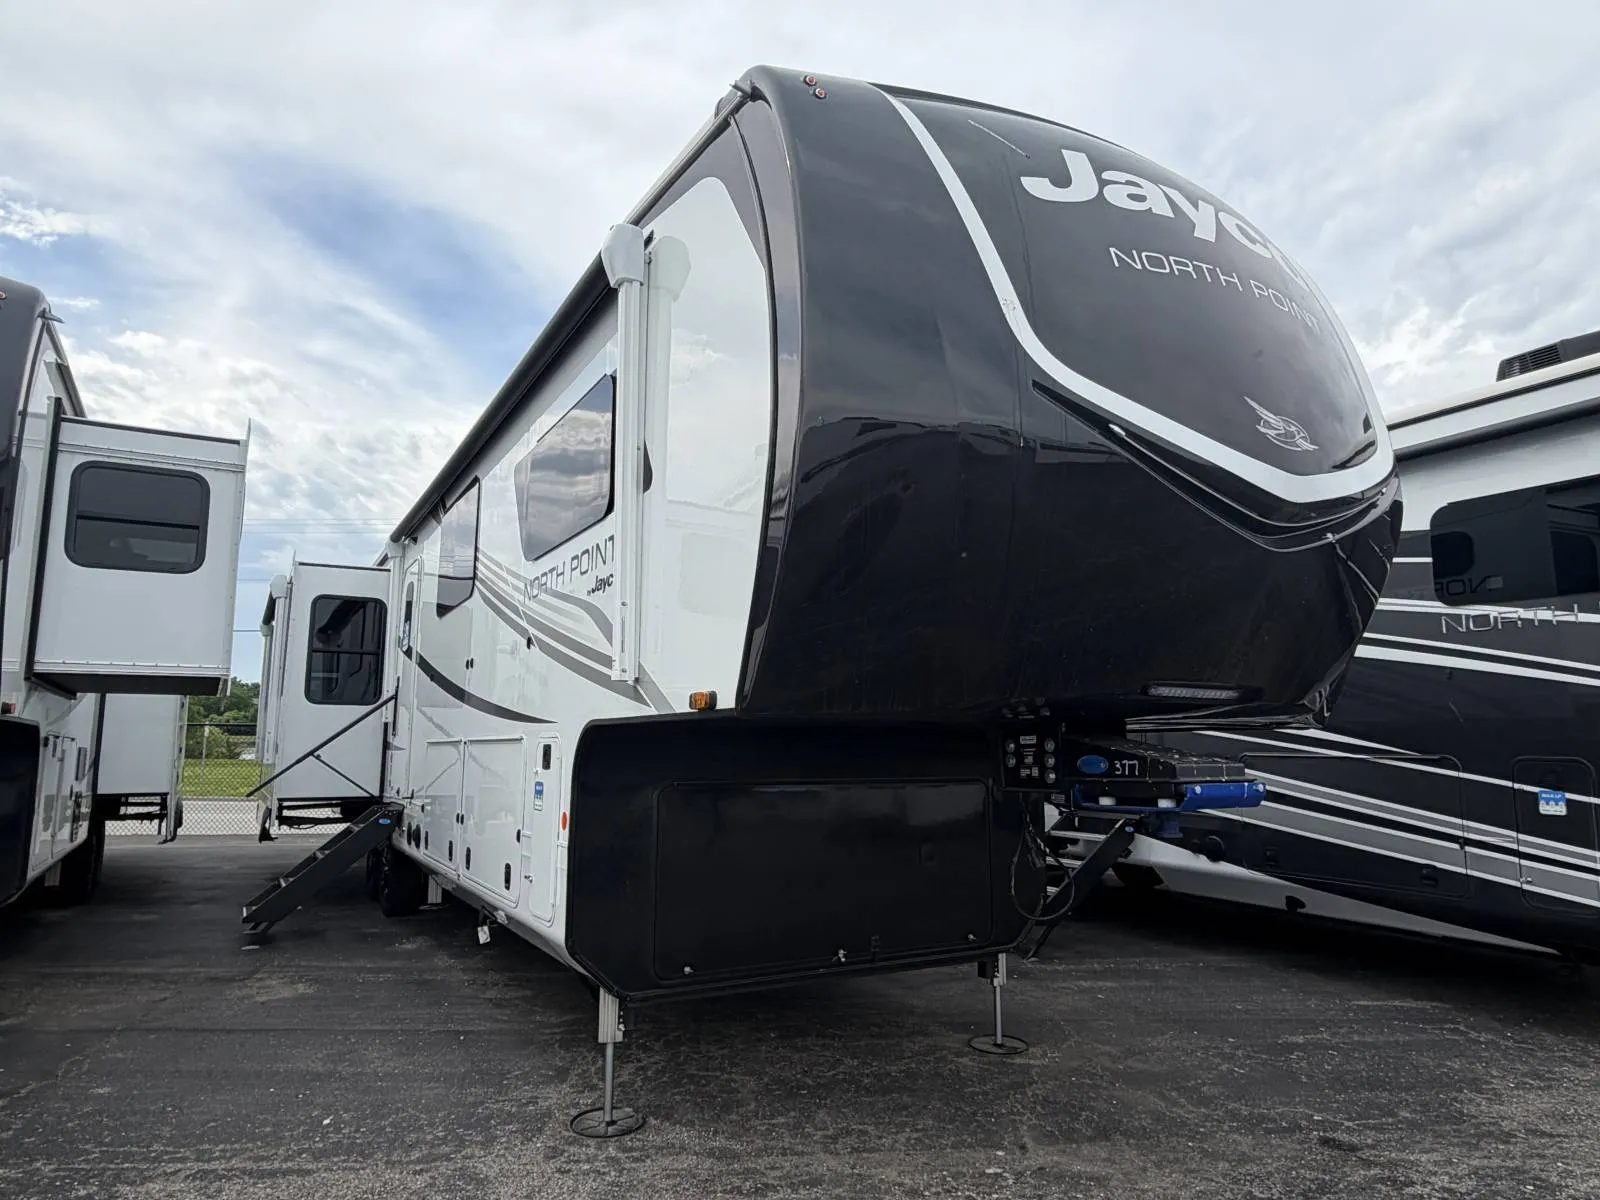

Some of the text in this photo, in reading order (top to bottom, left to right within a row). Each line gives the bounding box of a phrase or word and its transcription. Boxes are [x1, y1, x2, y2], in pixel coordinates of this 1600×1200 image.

[1108, 246, 1320, 335] NORTH POINT
[523, 534, 615, 606] NORTH POINT
[591, 573, 614, 594] Jayc
[1441, 603, 1579, 634] NORTH
[1114, 759, 1139, 776] 377
